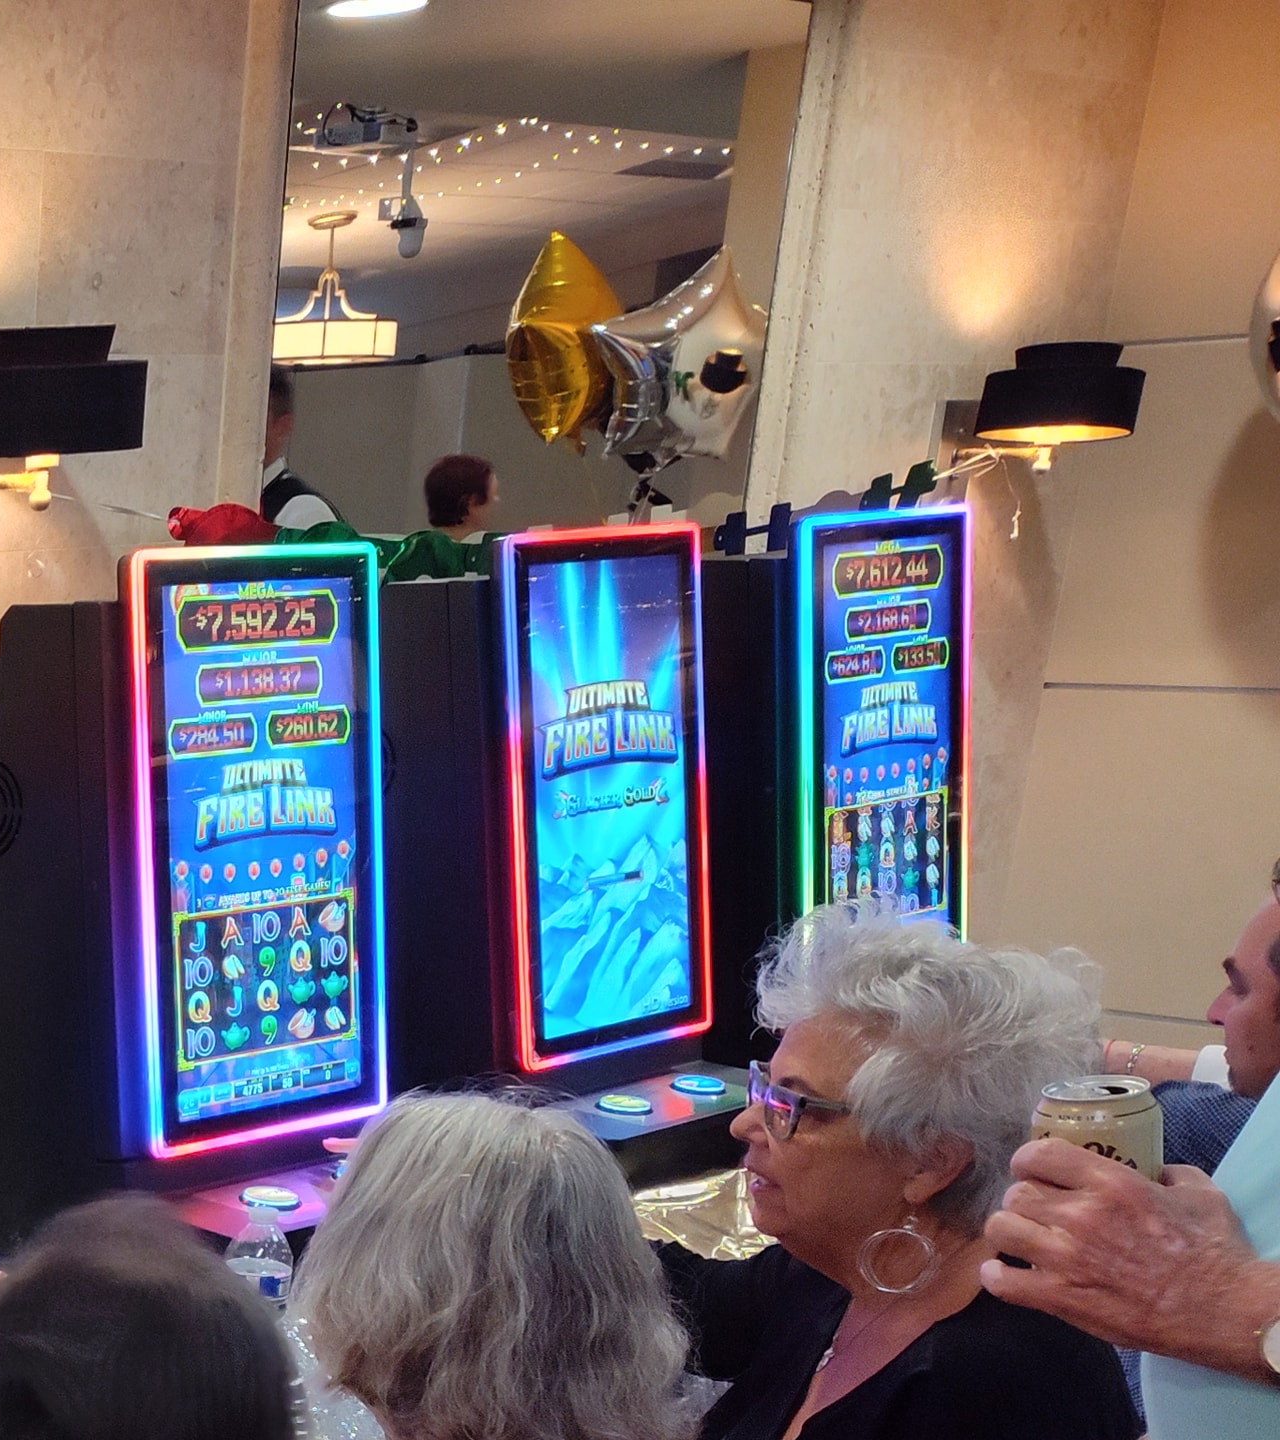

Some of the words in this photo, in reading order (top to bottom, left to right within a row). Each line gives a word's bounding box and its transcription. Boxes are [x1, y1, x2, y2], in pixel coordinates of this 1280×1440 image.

[875, 540, 900, 554] MEGA
[846, 554, 928, 588] $7,612.44
[238, 583, 275, 599] MEGA
[195, 600, 316, 641] $7,592.25
[242, 651, 277, 665] MAJOR
[215, 665, 301, 697] $1,138.37
[860, 681, 919, 708] ULTIMATE
[569, 681, 648, 717] ULTIMATE
[198, 710, 227, 724] MINOR
[276, 713, 338, 742] $260.62
[841, 708, 889, 750] FIRE
[892, 701, 936, 735] LINK
[178, 722, 245, 750] $284.50
[541, 717, 608, 769] FIRE
[615, 710, 676, 752] LINK
[222, 759, 306, 790] ULTIMATE
[624, 786, 656, 806] GOLD
[194, 790, 265, 845] FIRE
[270, 784, 335, 827] LINK
[190, 921, 207, 952] J
[221, 916, 244, 949] A
[252, 911, 281, 944] 10
[289, 906, 311, 938] A
[259, 946, 276, 976] 9
[290, 940, 312, 972] Q
[320, 935, 347, 968] 10
[184, 958, 213, 989] 10
[187, 991, 212, 1023] Q
[226, 986, 243, 1017] J
[257, 979, 280, 1011] Q
[186, 1026, 216, 1059] 10
[260, 1015, 278, 1045] 9
[243, 1083, 263, 1096] 4775
